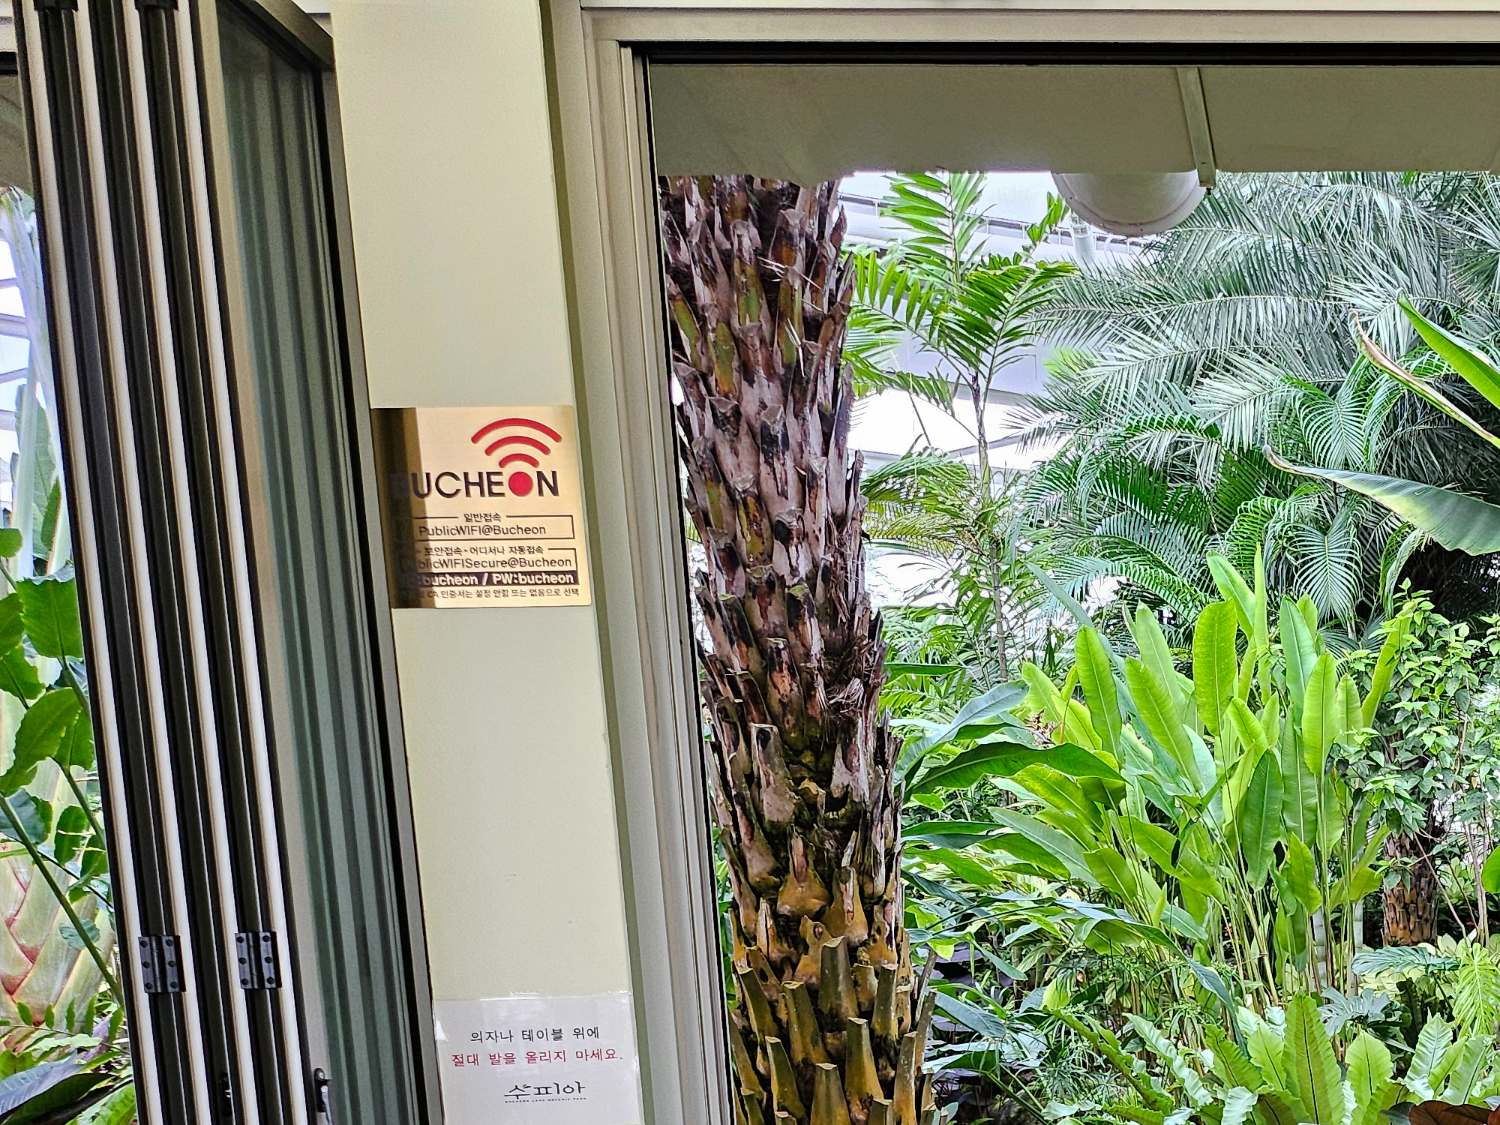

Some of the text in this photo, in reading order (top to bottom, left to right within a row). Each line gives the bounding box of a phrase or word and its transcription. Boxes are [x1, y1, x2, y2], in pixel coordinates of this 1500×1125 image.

[463, 512, 502, 524] 일반접속
[418, 524, 547, 537] PublicWIFI@Bucheon
[508, 545, 544, 555] 자동접속
[401, 557, 572, 570] blicWIFISecure@Bucheon
[491, 572, 575, 585] PW:bucheon
[470, 1026, 600, 1044] 의자나 테이블 위에
[451, 1047, 623, 1067] 절대 발을 올리지 마세요.
[503, 1080, 586, 1100] 수피아
